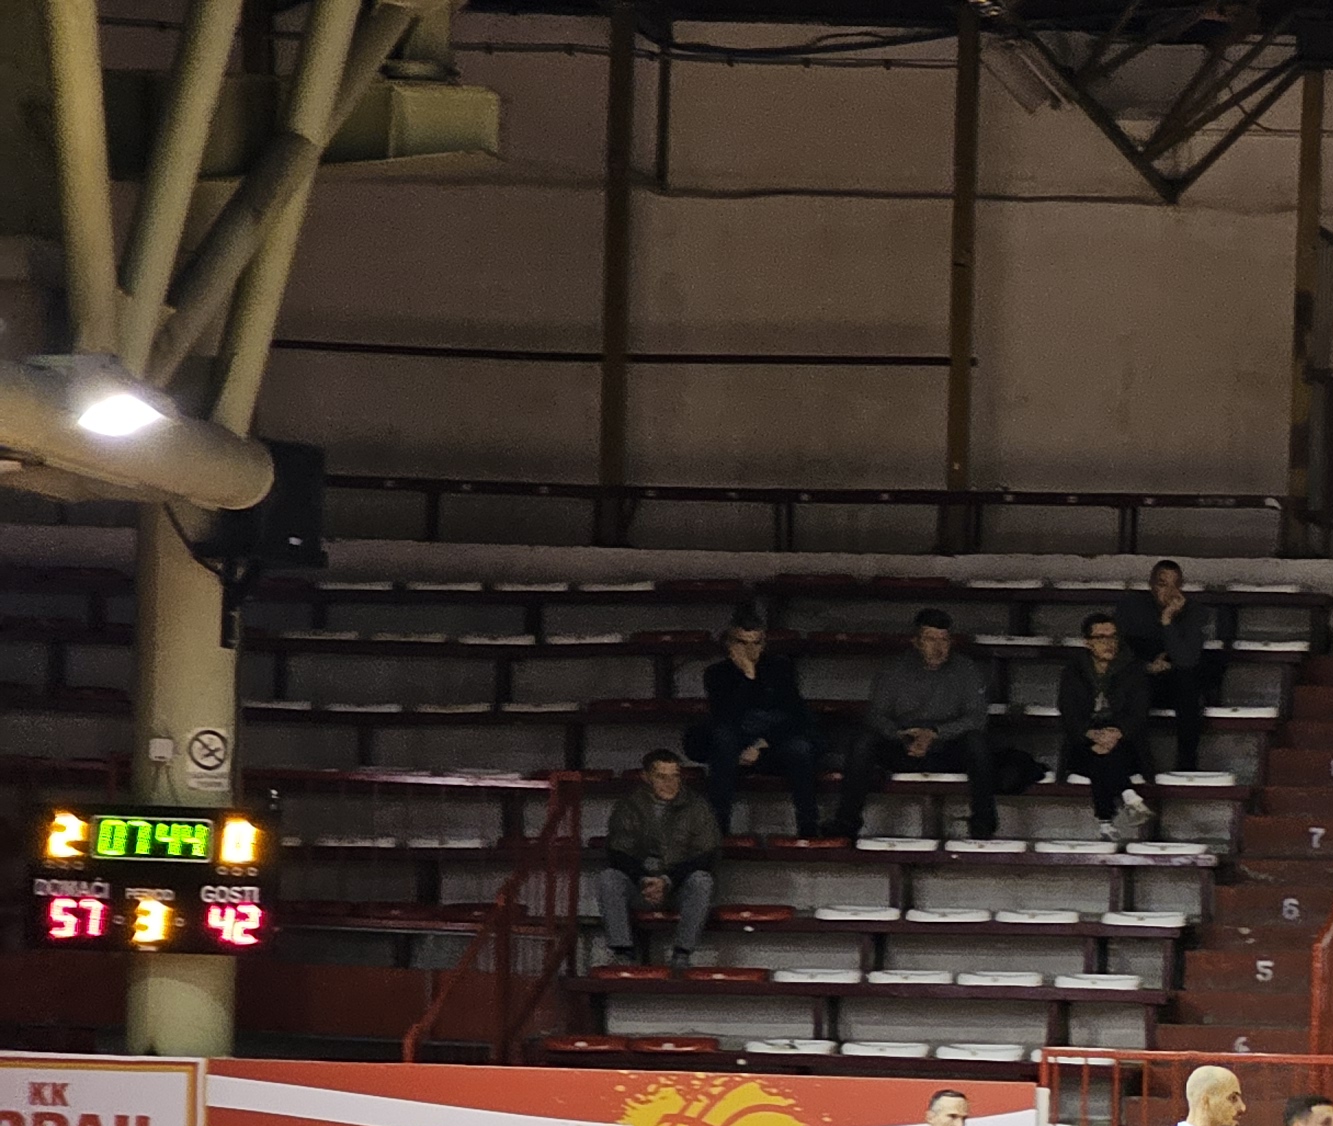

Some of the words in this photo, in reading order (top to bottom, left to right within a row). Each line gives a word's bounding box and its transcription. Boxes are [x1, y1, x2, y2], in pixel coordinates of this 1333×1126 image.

[48, 811, 86, 858] 2
[1309, 827, 1326, 849] 7
[201, 884, 262, 903] GOSTI
[49, 897, 106, 939] 57
[131, 899, 173, 943] 3
[207, 904, 262, 945] 42
[1282, 899, 1300, 921] 6
[1256, 960, 1274, 982] 5
[28, 1081, 70, 1107] КК
